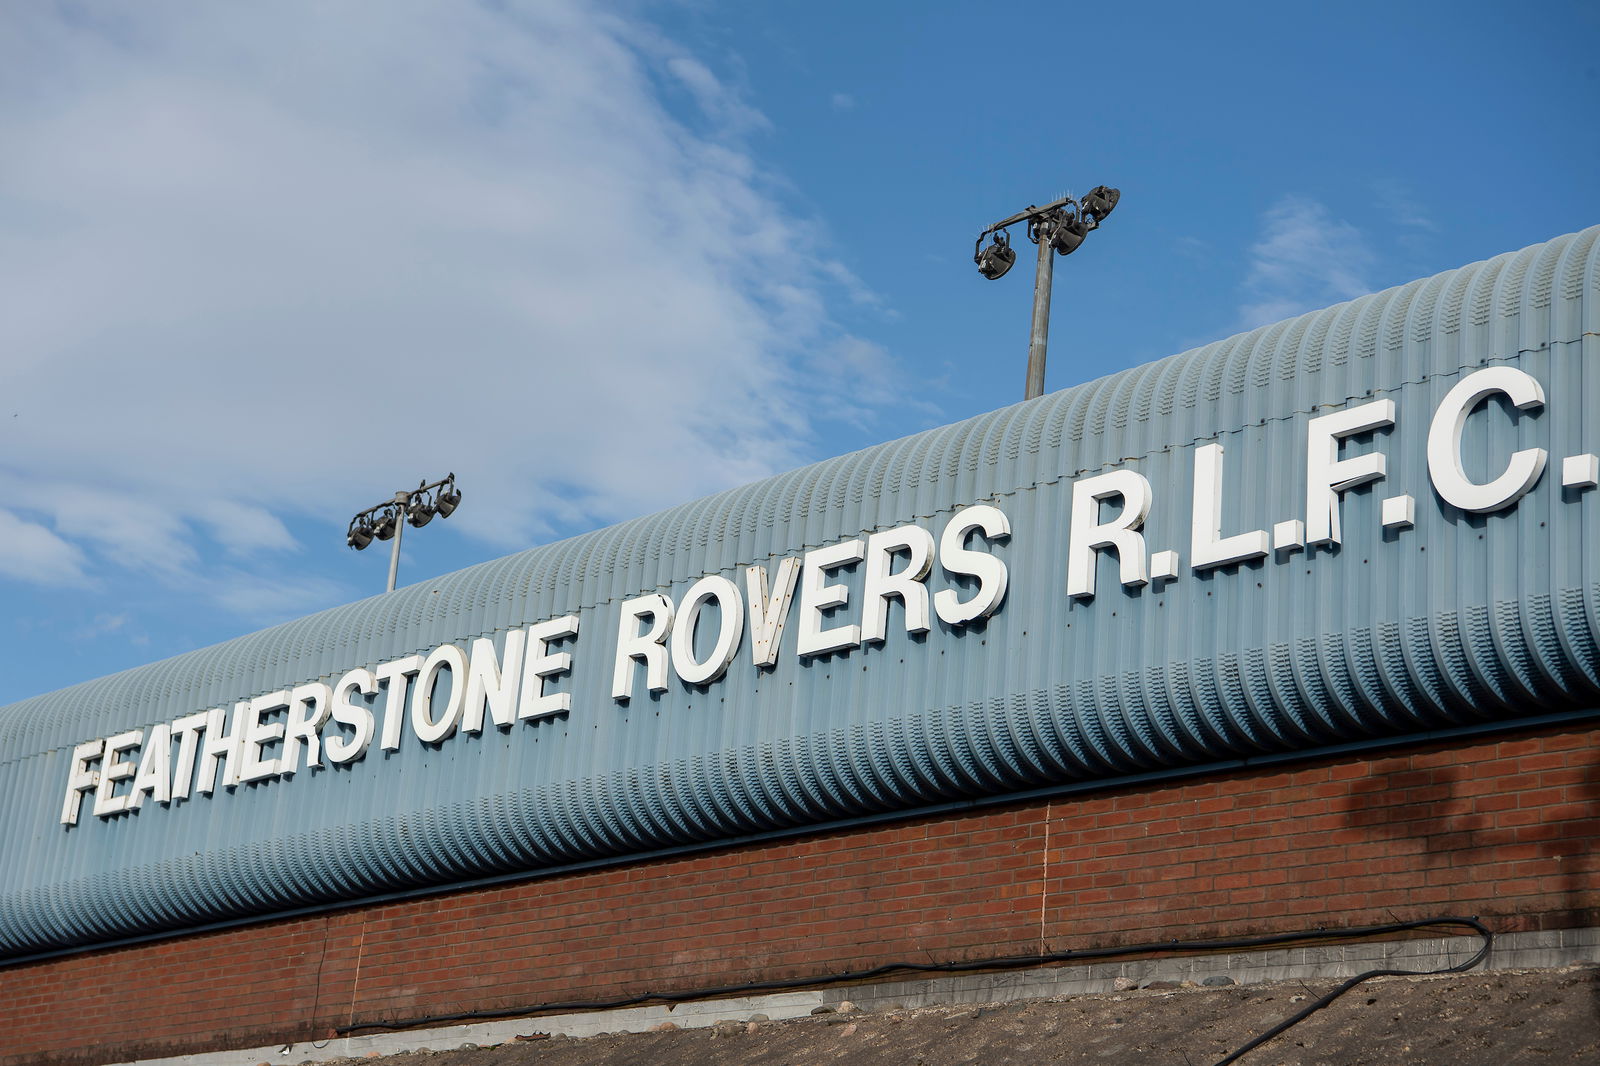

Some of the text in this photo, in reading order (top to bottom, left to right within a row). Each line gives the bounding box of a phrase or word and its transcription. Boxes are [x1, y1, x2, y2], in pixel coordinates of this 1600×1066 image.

[60, 366, 1598, 826] FEATHERSTONE ROVERS R.L.F.C.
